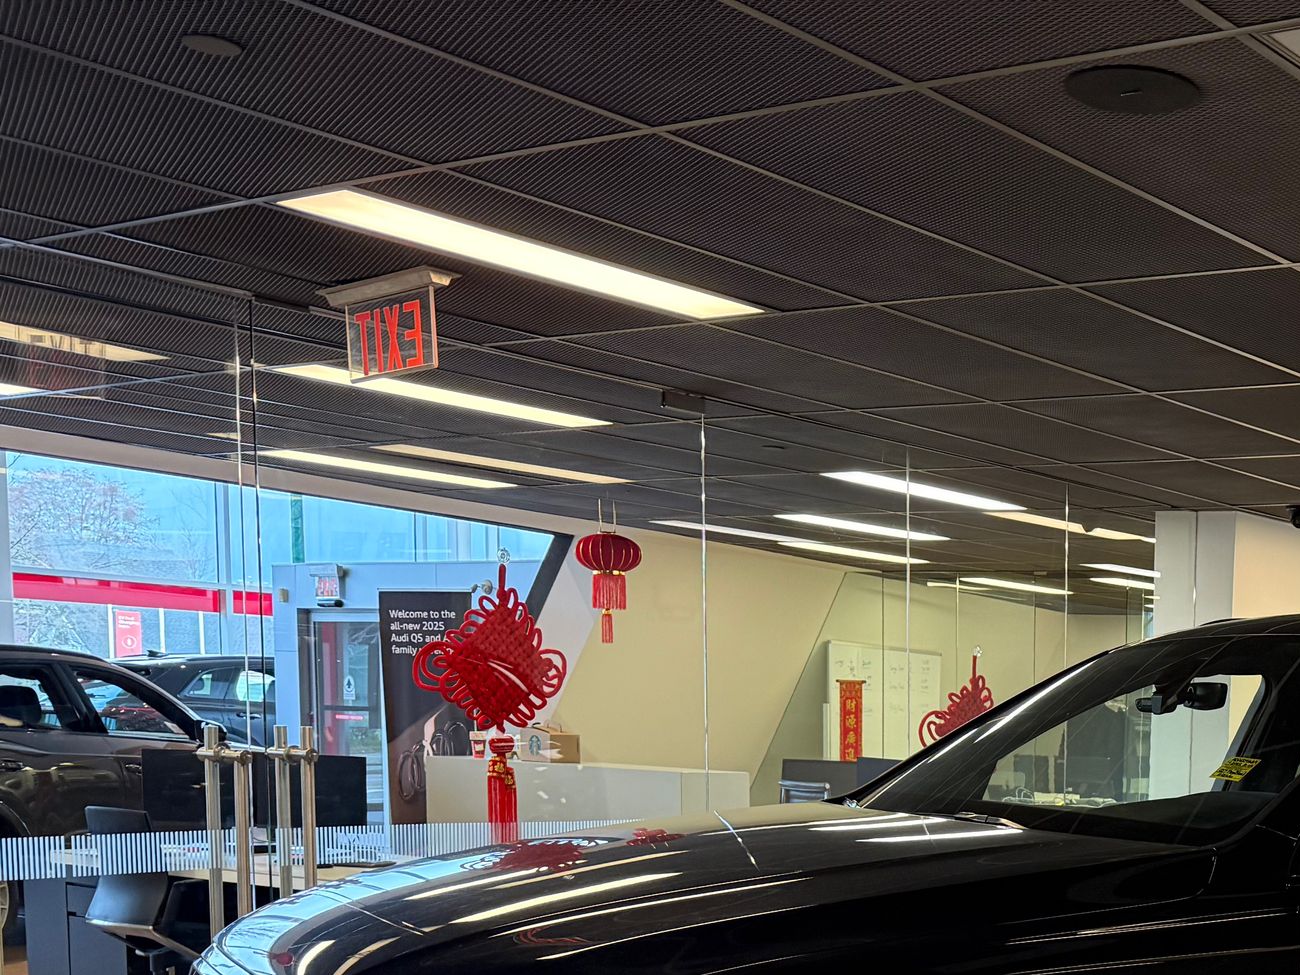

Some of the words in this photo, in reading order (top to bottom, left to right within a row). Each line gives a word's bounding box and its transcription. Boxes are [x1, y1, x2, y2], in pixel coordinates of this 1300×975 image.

[389, 609, 428, 619] Welcome
[430, 610, 439, 619] to
[441, 609, 456, 619] the
[390, 621, 420, 631] all-new
[422, 621, 445, 631] 2025
[390, 633, 409, 643] Audi
[410, 633, 423, 643] Q5
[425, 633, 441, 643] and
[391, 645, 417, 657] family
